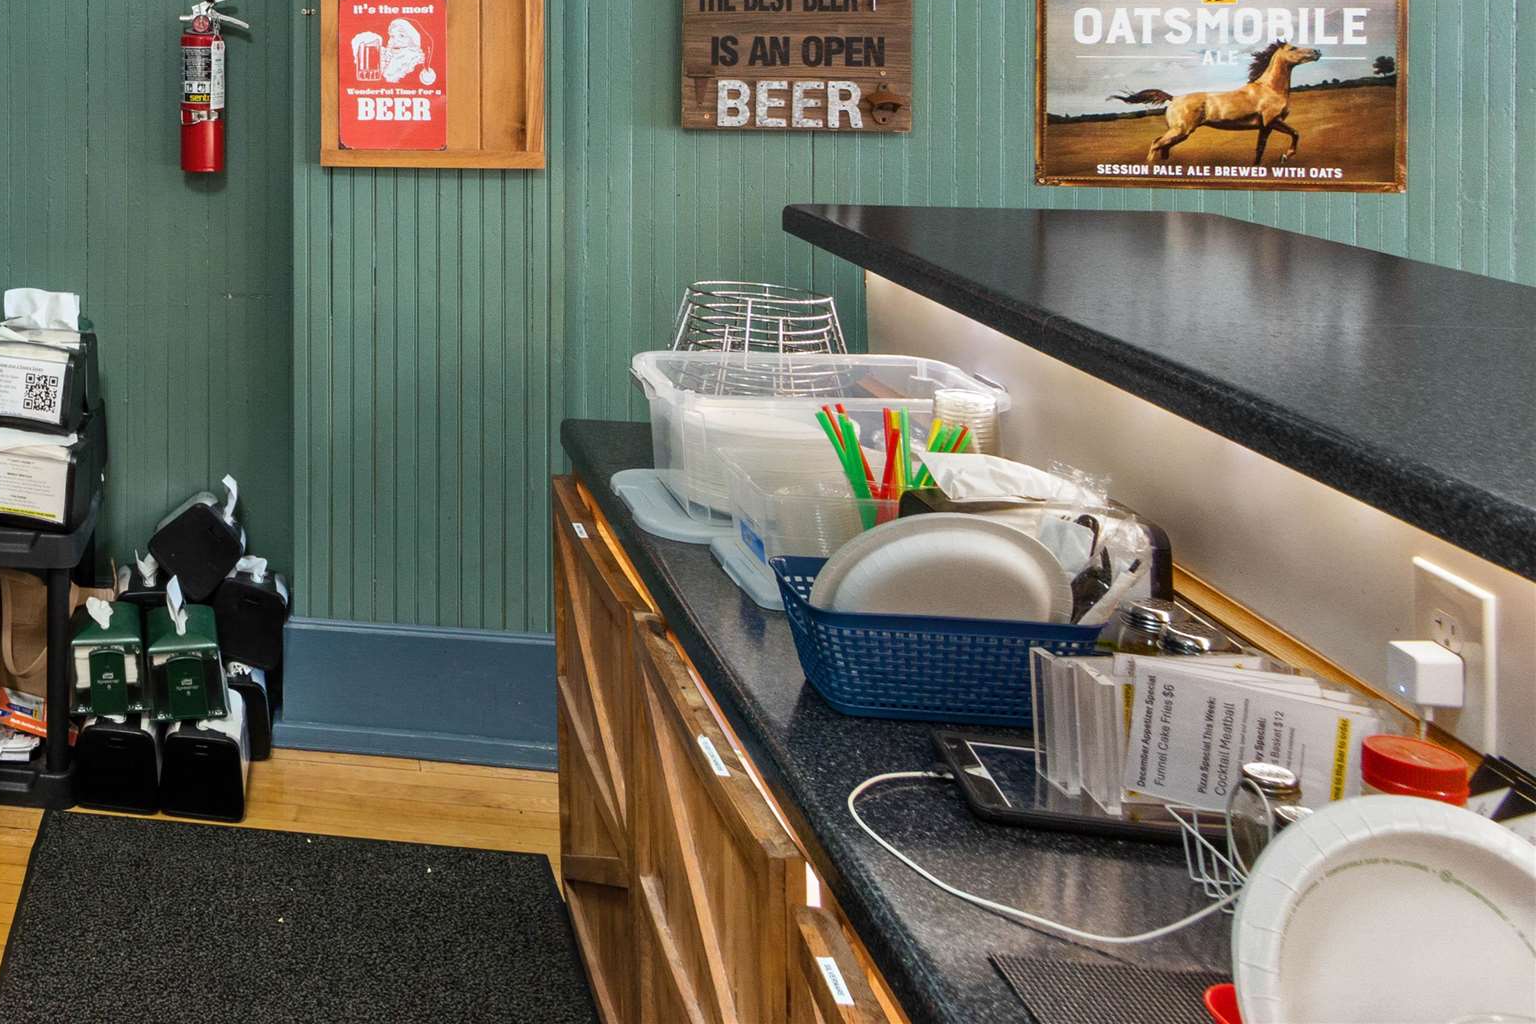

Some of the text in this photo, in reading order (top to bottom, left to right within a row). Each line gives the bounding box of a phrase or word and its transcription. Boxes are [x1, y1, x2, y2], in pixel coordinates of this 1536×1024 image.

[353, 4, 434, 15] It's the most
[1074, 7, 1370, 44] OATSMOBILE
[711, 36, 885, 67] IS AN OPEN
[1202, 50, 1239, 65] ALE
[347, 88, 394, 96] Wonderful
[357, 97, 432, 121] BEER
[717, 79, 863, 128] BEER
[1097, 163, 1342, 178] SESSION PALE ALE BREWED WITH OATS
[1137, 675, 1156, 787] December Appetizer Special
[1154, 684, 1175, 787] Funnel Cake Fries $6
[1198, 696, 1216, 794] Pizza Special This Week:
[1215, 703, 1235, 796] Cocktail Meatball
[1271, 710, 1285, 758] Basket $12
